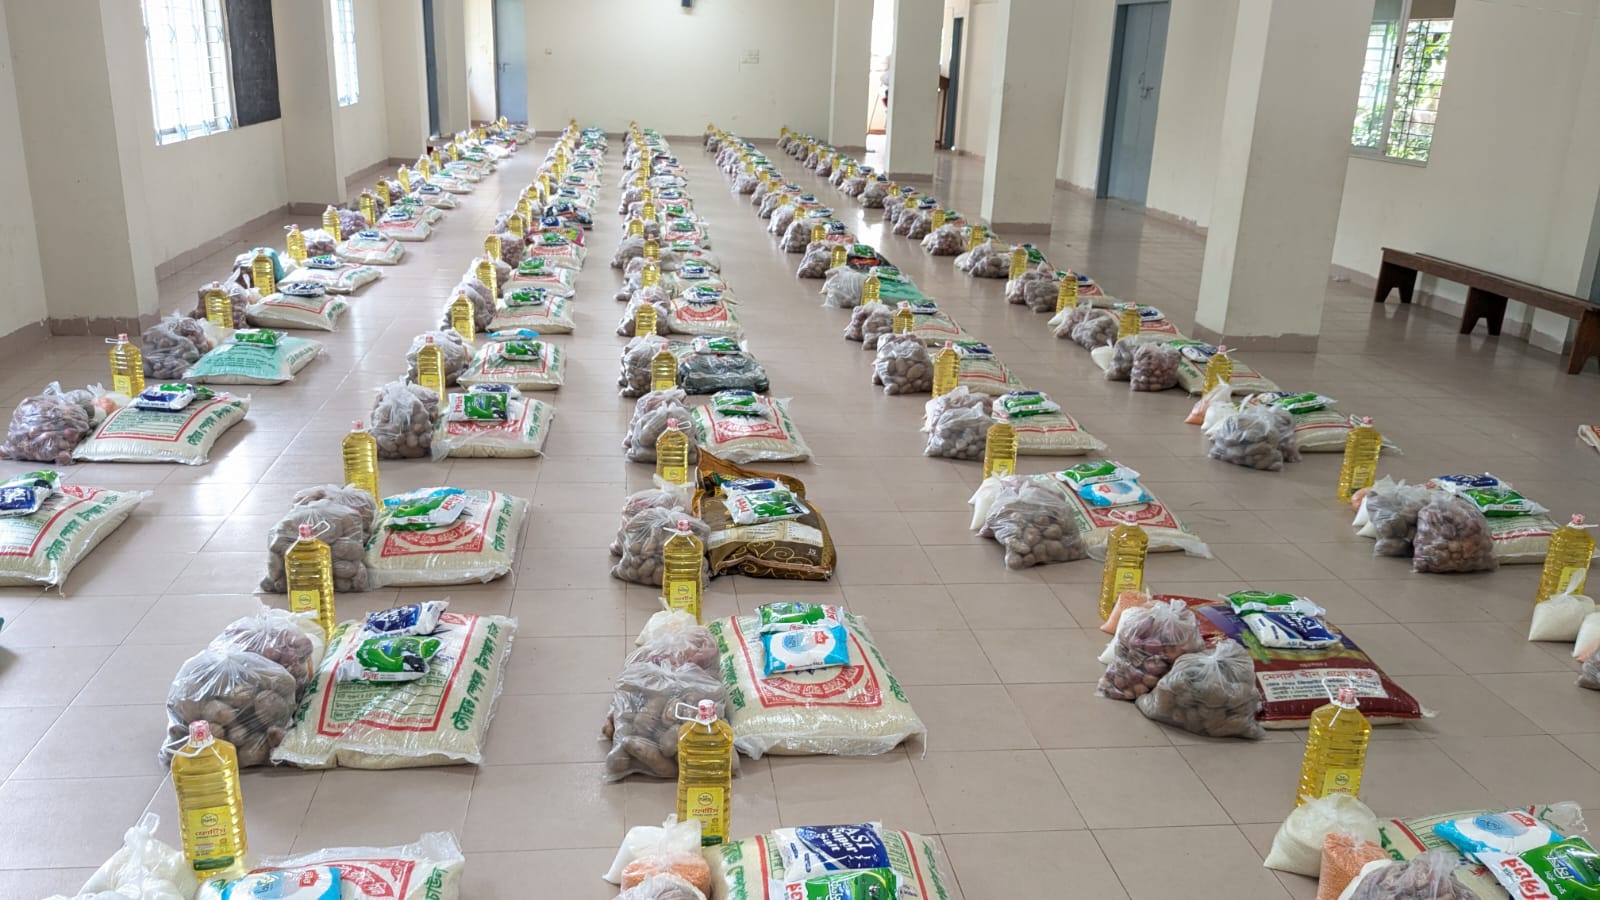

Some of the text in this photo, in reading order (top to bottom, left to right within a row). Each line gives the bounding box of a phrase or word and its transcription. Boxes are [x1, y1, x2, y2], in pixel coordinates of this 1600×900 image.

[819, 832, 841, 851] Salt
[828, 827, 858, 853] Super
[841, 827, 875, 849] ASI
